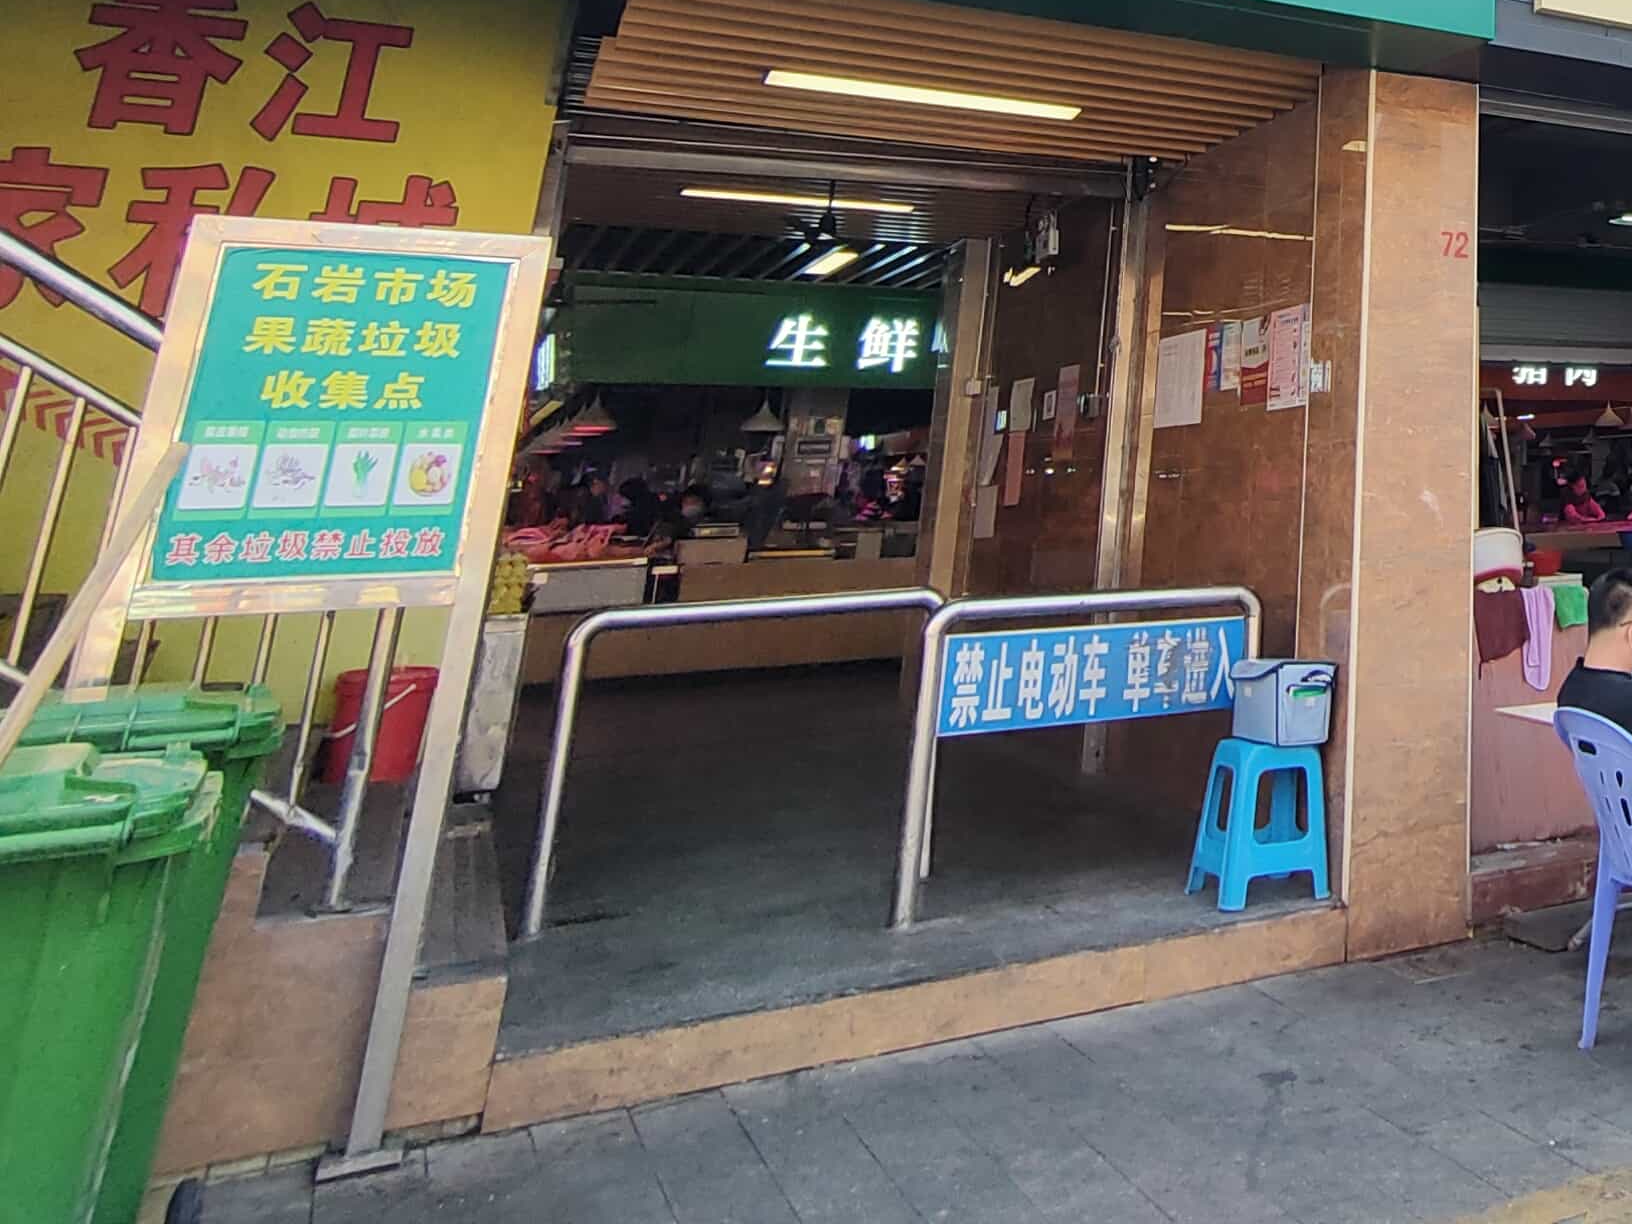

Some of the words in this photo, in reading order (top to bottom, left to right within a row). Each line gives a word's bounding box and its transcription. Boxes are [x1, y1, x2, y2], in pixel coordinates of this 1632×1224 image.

[1440, 231, 1469, 258] 72
[252, 262, 478, 309] 石岩市场
[242, 316, 462, 358] 果蔬垃圾
[764, 312, 949, 373] 生鲜
[259, 369, 425, 410] 收集点
[166, 527, 445, 567] 其余垃圾禁止投放
